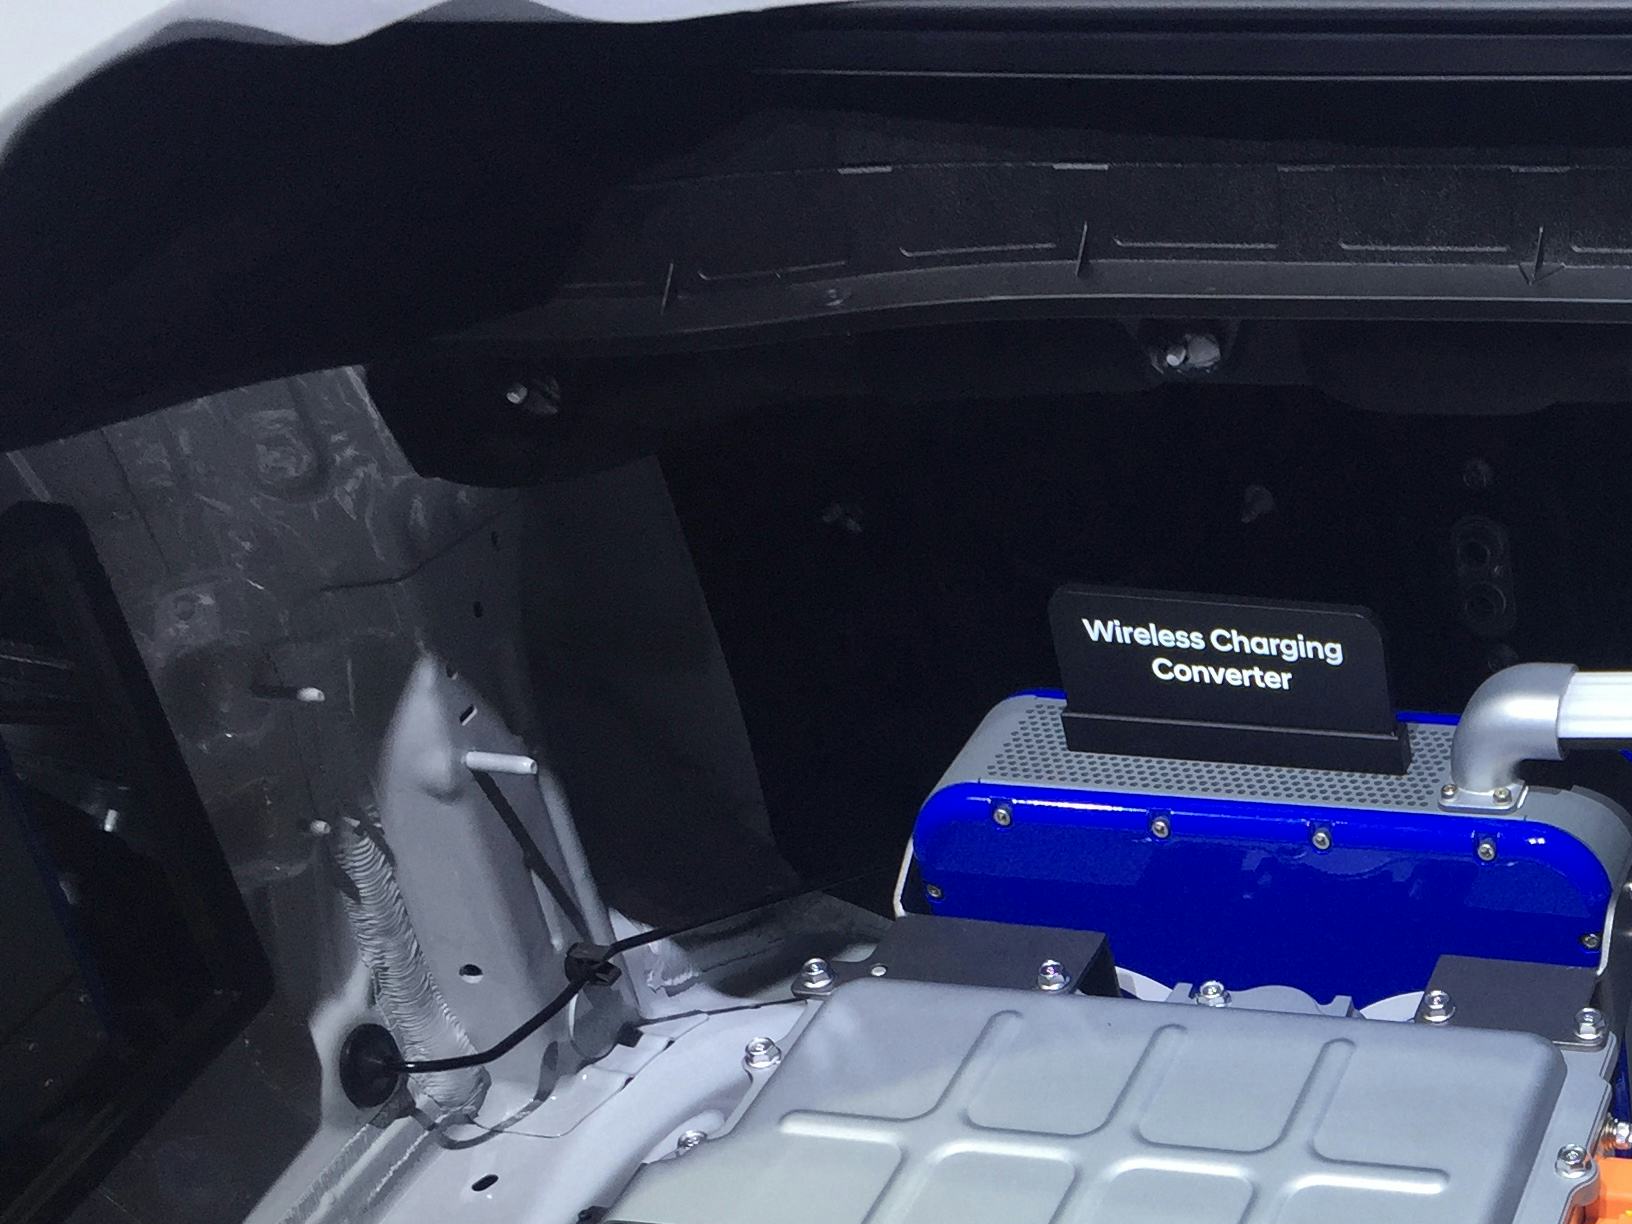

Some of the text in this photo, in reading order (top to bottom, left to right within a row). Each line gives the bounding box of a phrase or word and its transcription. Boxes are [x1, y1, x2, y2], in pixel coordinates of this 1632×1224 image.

[1081, 618, 1344, 666] Wireless Charging
[1151, 657, 1293, 690] Converter
